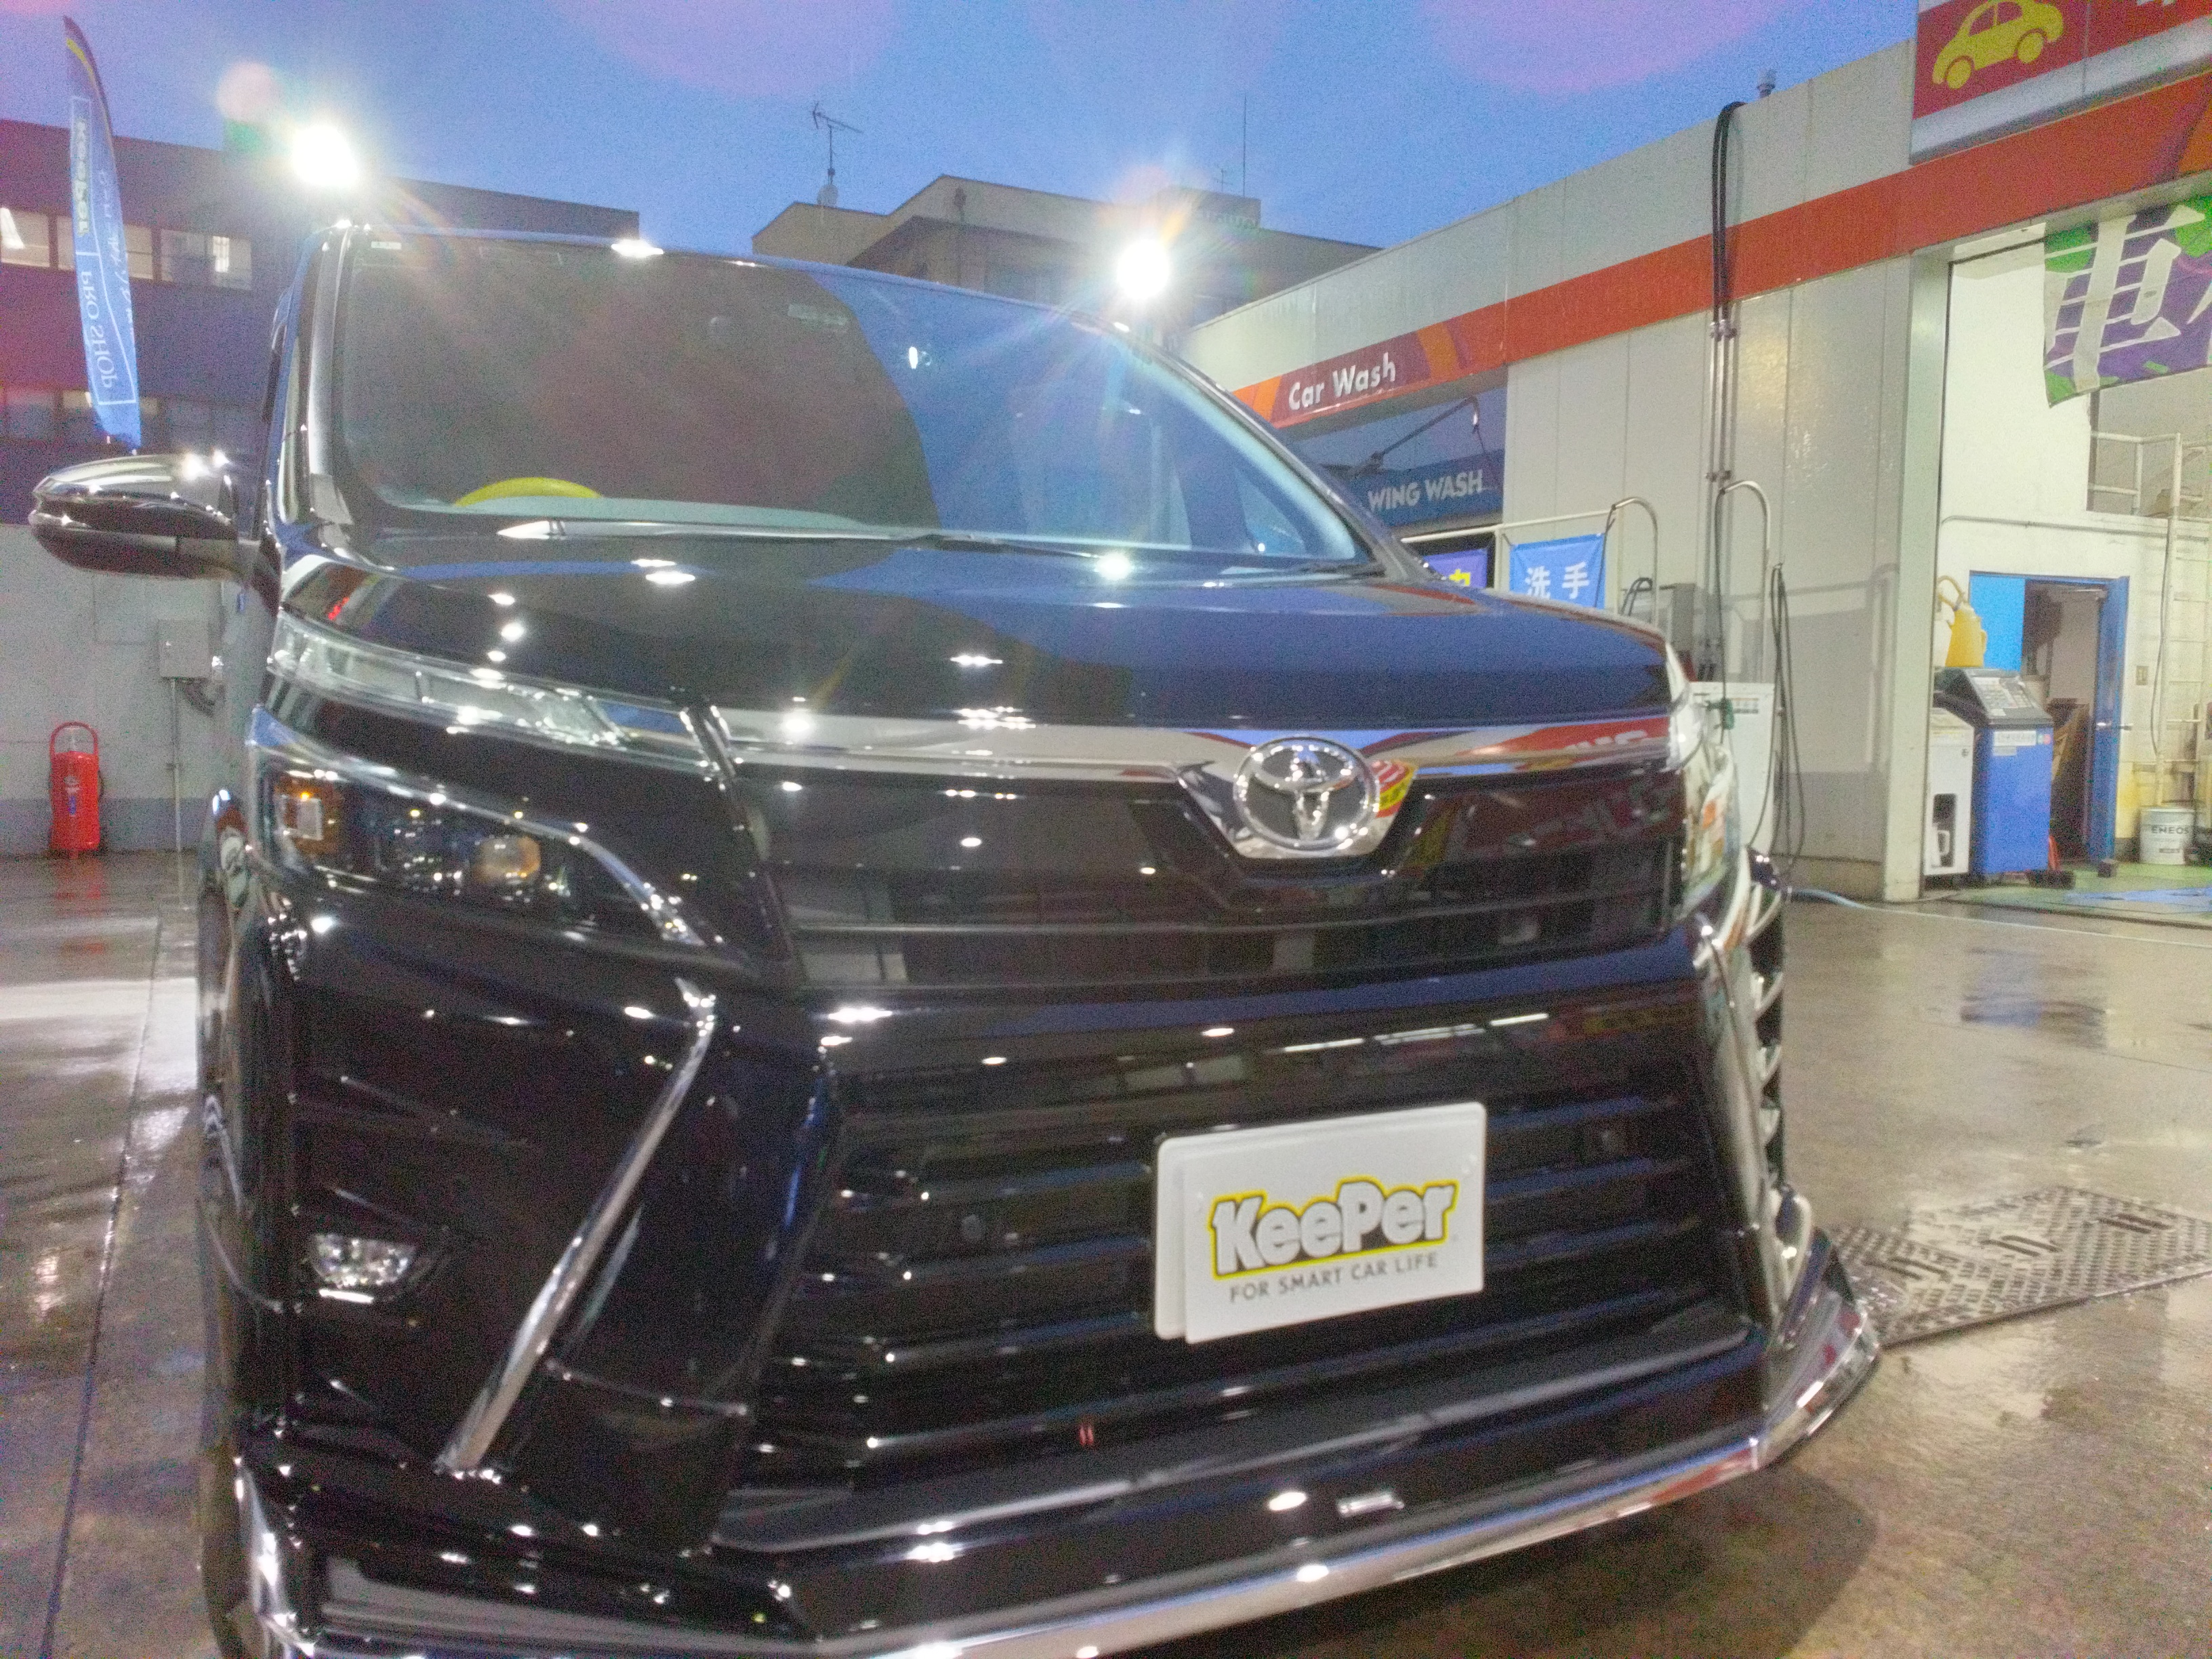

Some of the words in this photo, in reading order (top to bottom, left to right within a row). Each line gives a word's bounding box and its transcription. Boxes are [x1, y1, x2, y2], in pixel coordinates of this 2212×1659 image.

[1288, 381, 1324, 410] Car
[1332, 352, 1396, 398] Wash
[1368, 485, 1420, 512] WING
[1425, 469, 1483, 501] WASH
[2151, 824, 2190, 835] ENEOS
[1208, 1176, 1459, 1280] KeePer
[1229, 1282, 1271, 1303] FOR
[1278, 1267, 1343, 1293] SMART
[1351, 1263, 1387, 1283] CAR
[1395, 1250, 1439, 1273] LIFE
